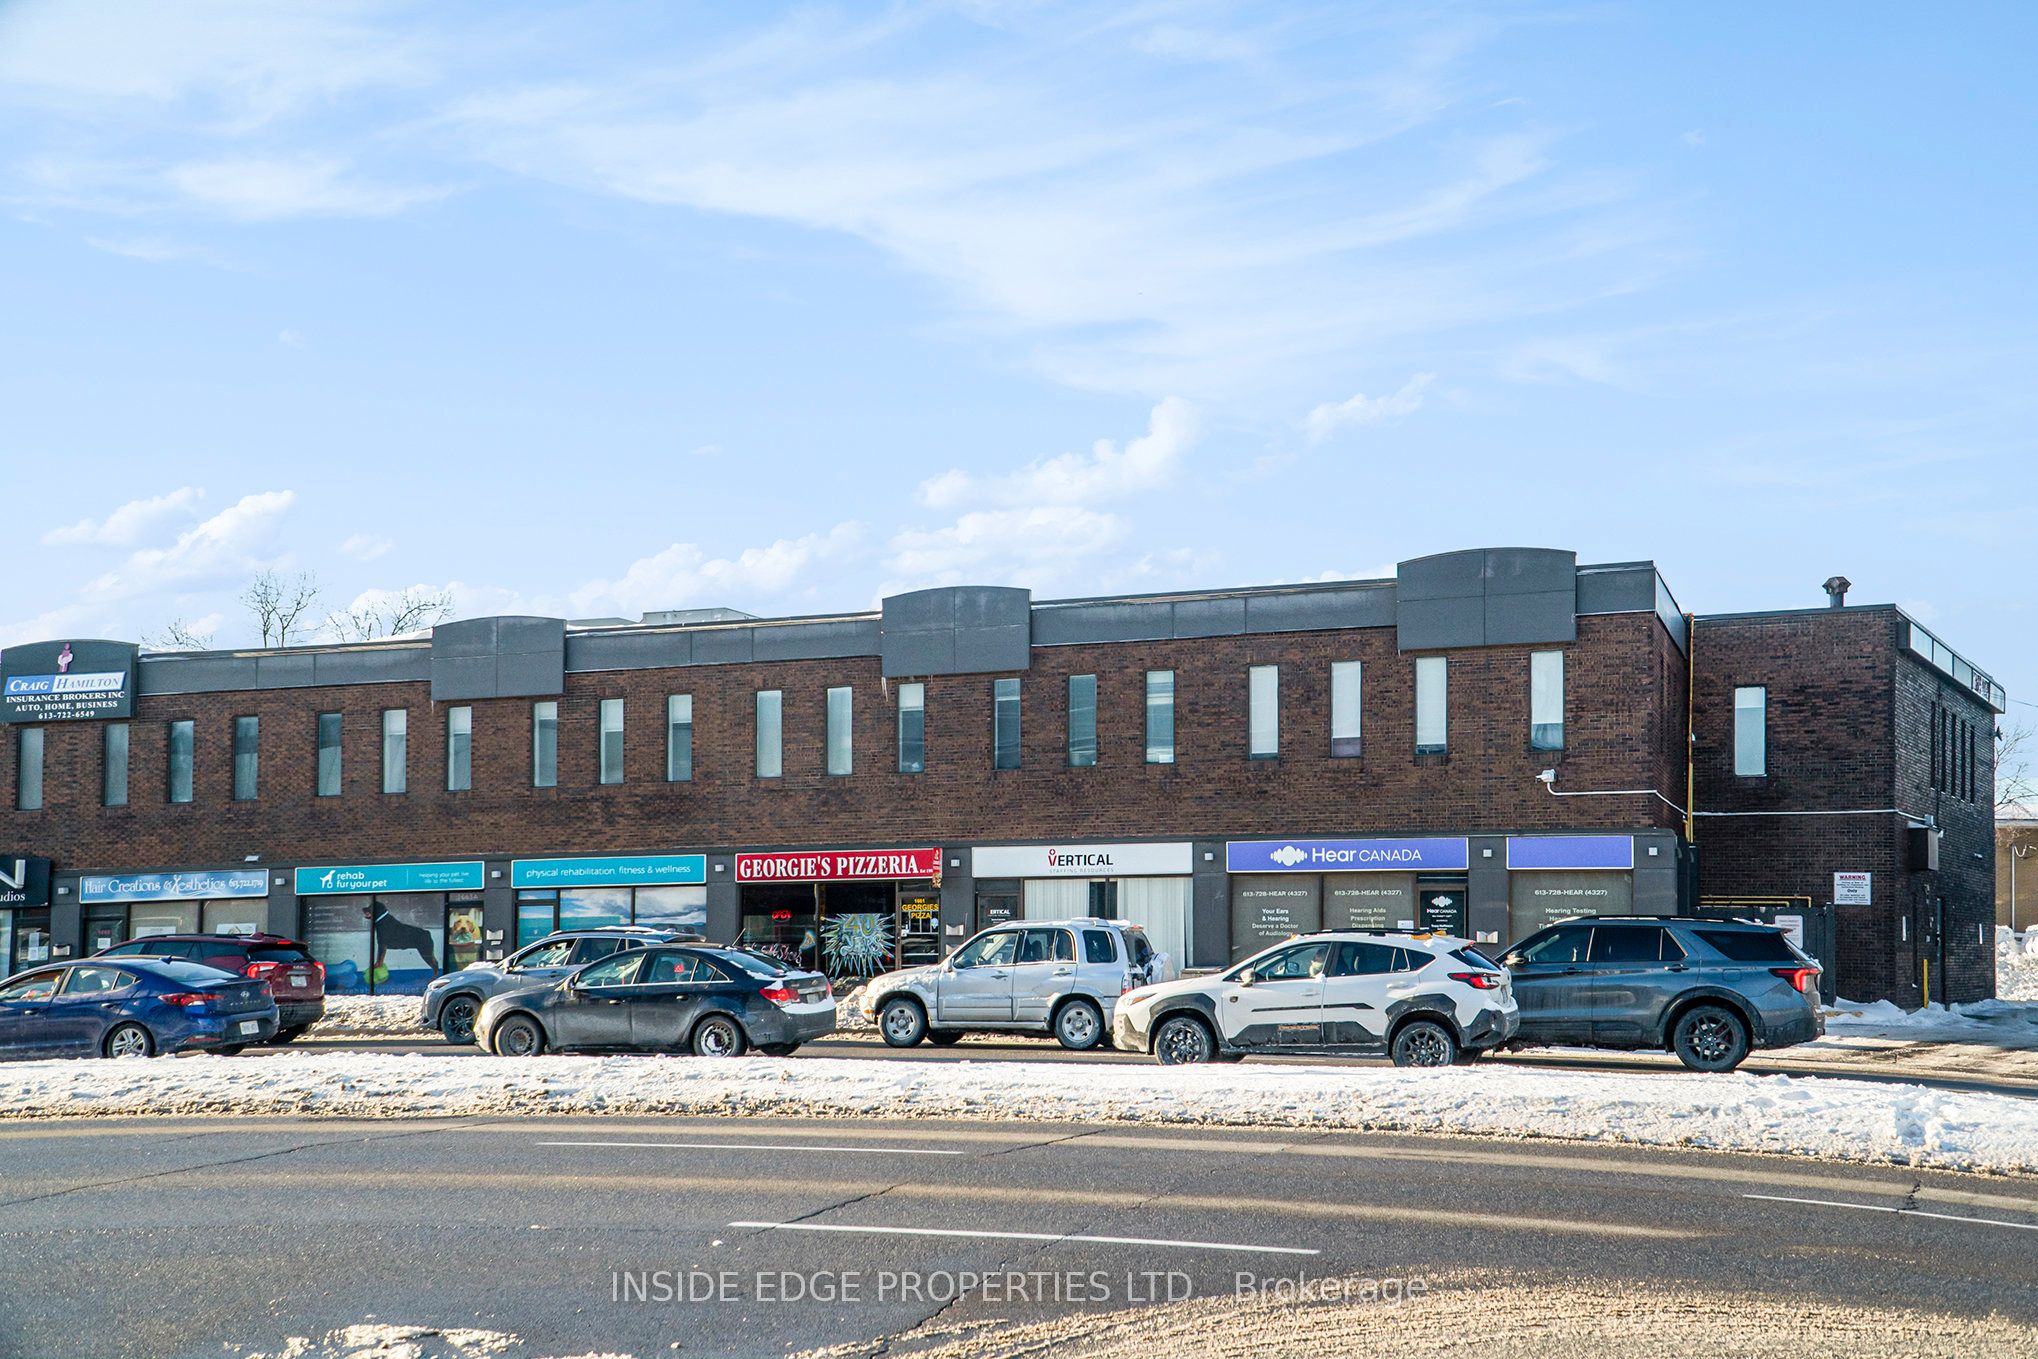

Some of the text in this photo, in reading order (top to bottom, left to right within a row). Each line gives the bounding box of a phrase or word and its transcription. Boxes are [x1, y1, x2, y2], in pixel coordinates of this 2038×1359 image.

[9, 677, 121, 692] CRAIG HAMILTON
[6, 691, 125, 703] INSURANCE BROKERS INC
[15, 701, 118, 712] AUTO, HOME, BUSINESS
[38, 711, 95, 719] 613-722-6549
[1048, 851, 1114, 867] VERTICAL
[1312, 847, 1422, 862] Hear CANADA
[526, 865, 691, 878] physical rehabilitation fitness & wellness
[739, 856, 831, 878] GEORGIE'S
[836, 855, 919, 876] PIZZERIA
[336, 871, 365, 880] rehab
[84, 881, 106, 894] Hair
[108, 879, 161, 893] Creations
[1334, 889, 1380, 897] 613-728-HEAR
[1585, 889, 1608, 897] (4327)
[901, 904, 939, 912] GEORGIES
